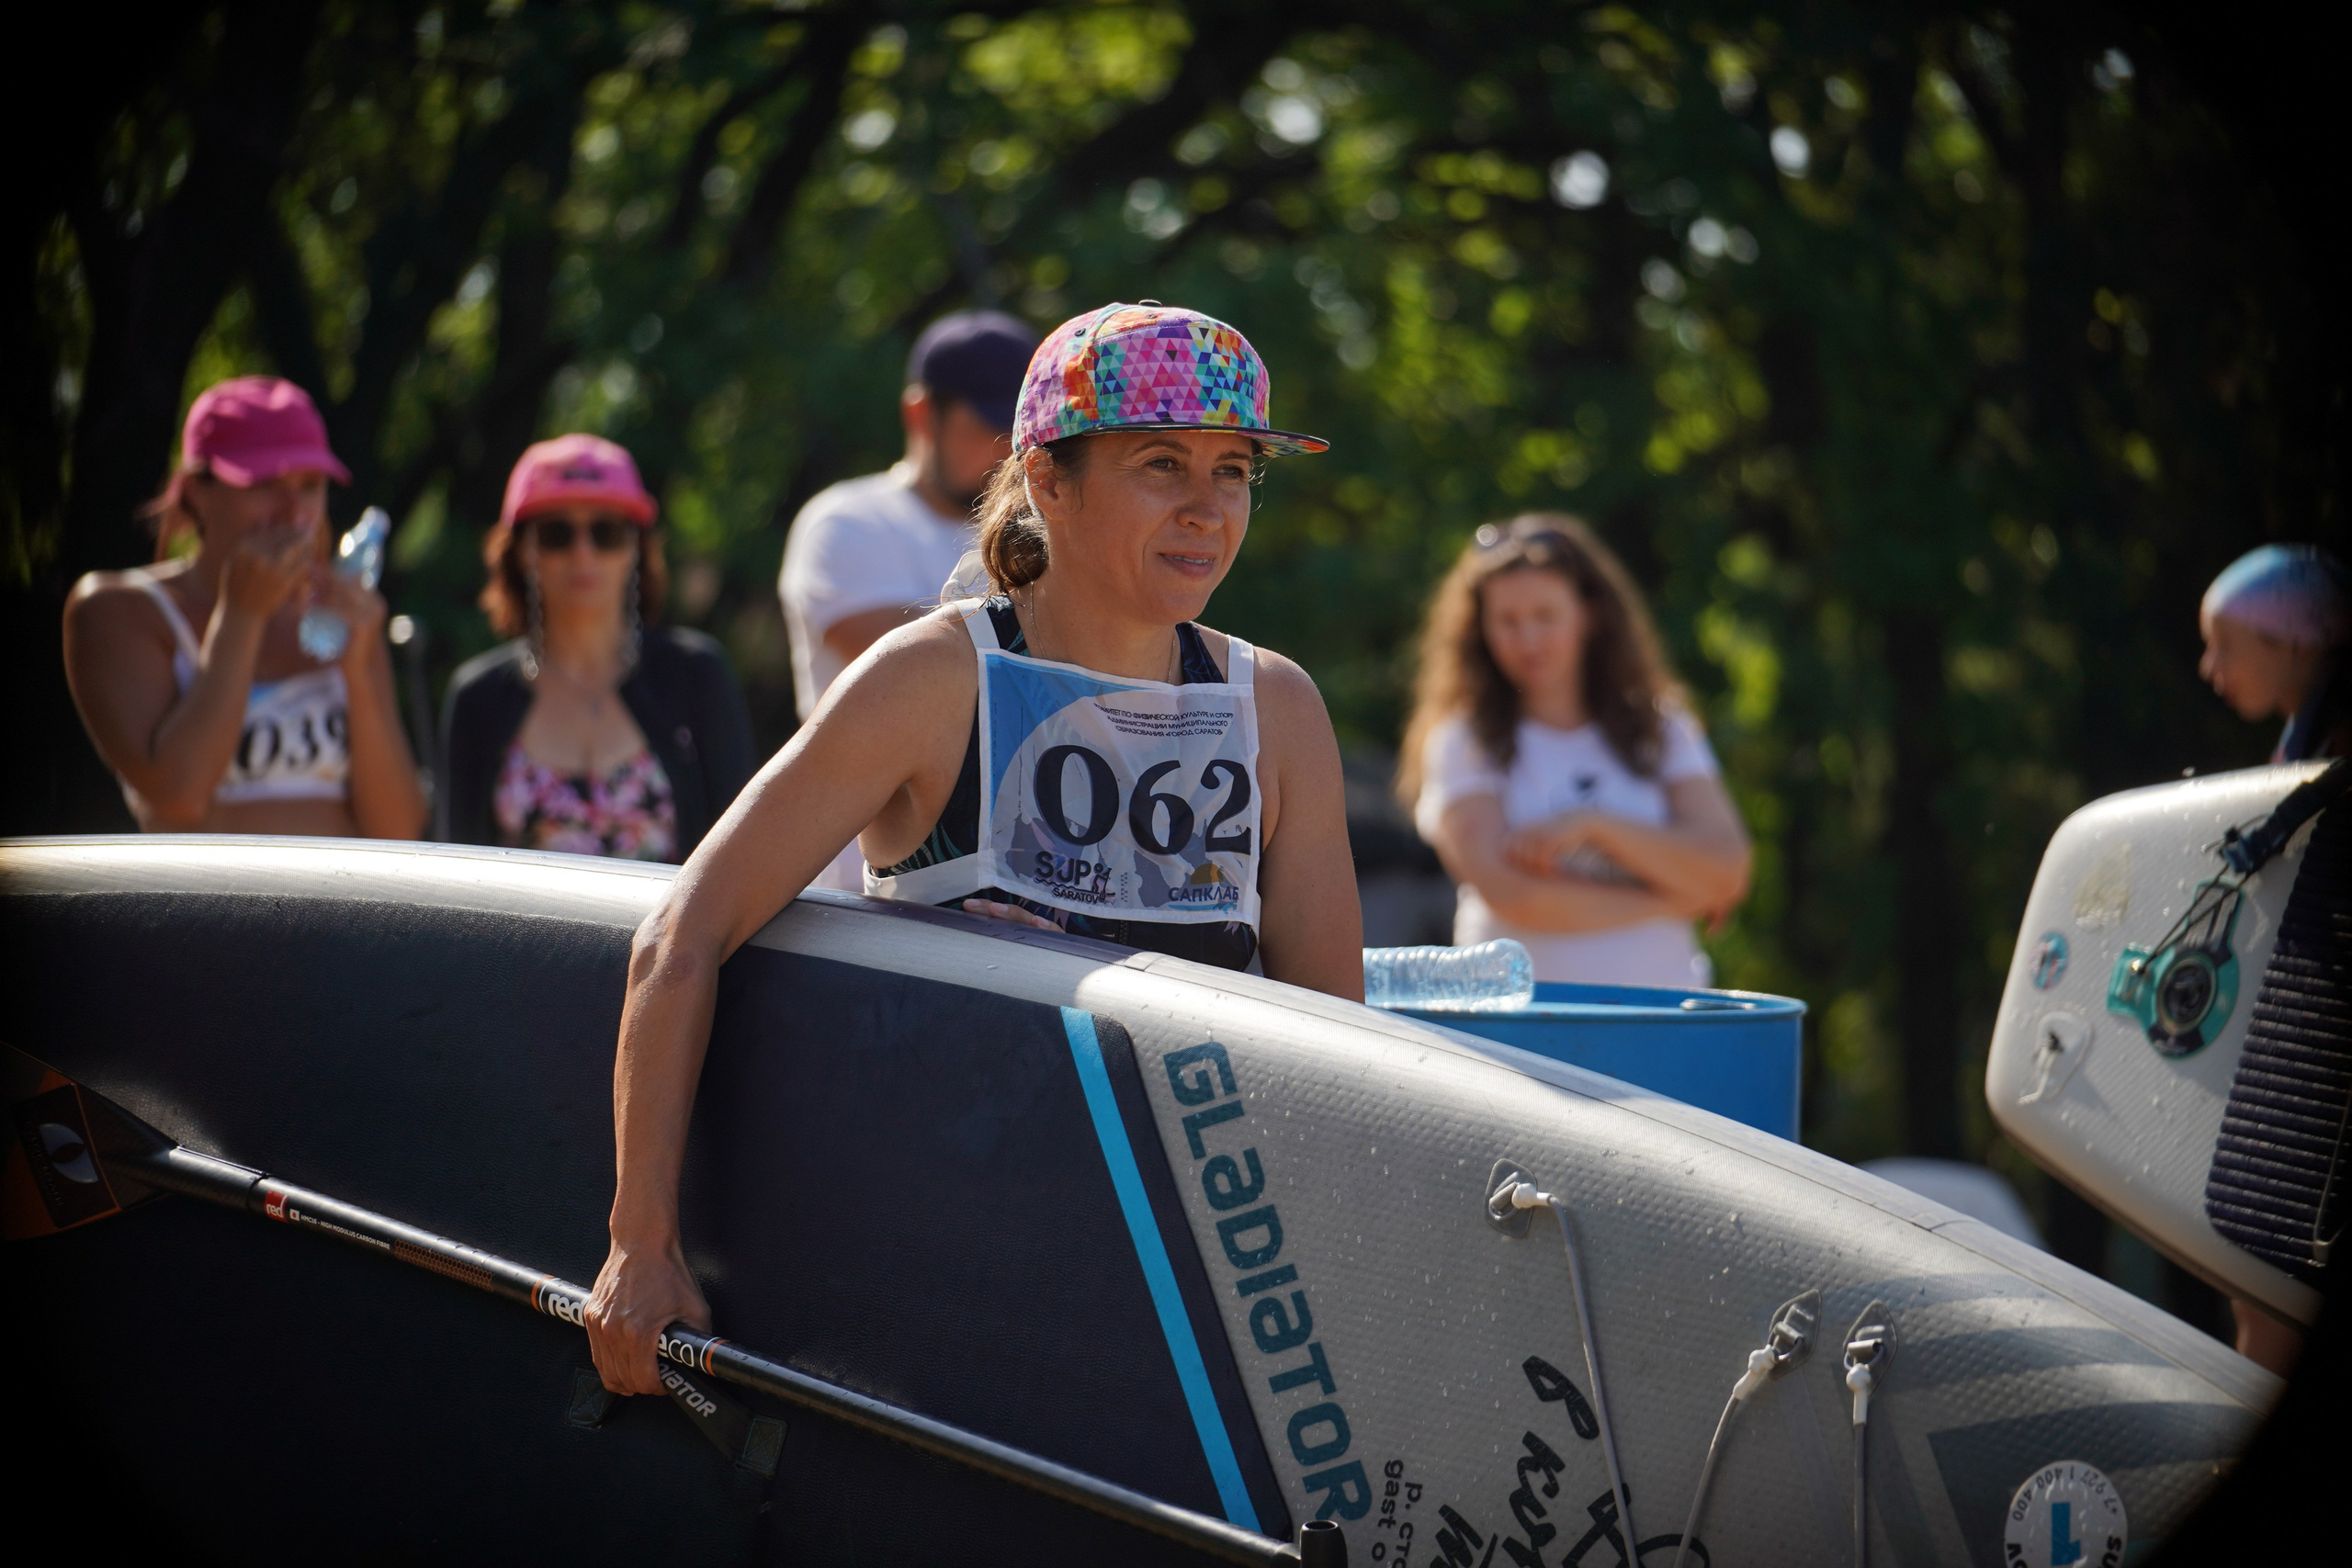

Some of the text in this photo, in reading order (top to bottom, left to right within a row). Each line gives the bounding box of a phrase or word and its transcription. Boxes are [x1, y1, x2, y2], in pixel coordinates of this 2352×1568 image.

[1122, 710, 1133, 718] ПО
[1133, 712, 1180, 722] ФИЗИЧЕСКОЙ
[1181, 711, 1209, 720] КУЛЬТУРЕ
[1168, 719, 1228, 729] МУНИЦИПАЛЬНОГО
[1115, 725, 1165, 737] ОБРАЗОВАНИЯ
[1033, 744, 1251, 855] 062
[1035, 851, 1091, 886] SUP
[1053, 887, 1101, 904] SARATOV
[1168, 886, 1239, 903] САПКЛАБ
[266, 1194, 288, 1219] red
[320, 1220, 333, 1230] HIGH
[333, 1224, 356, 1238] MODULUS
[356, 1233, 377, 1246] CARBON
[376, 1239, 390, 1250] FIBRE
[2035, 1468, 2064, 1490] 400
[2011, 1488, 2032, 1522] 400
